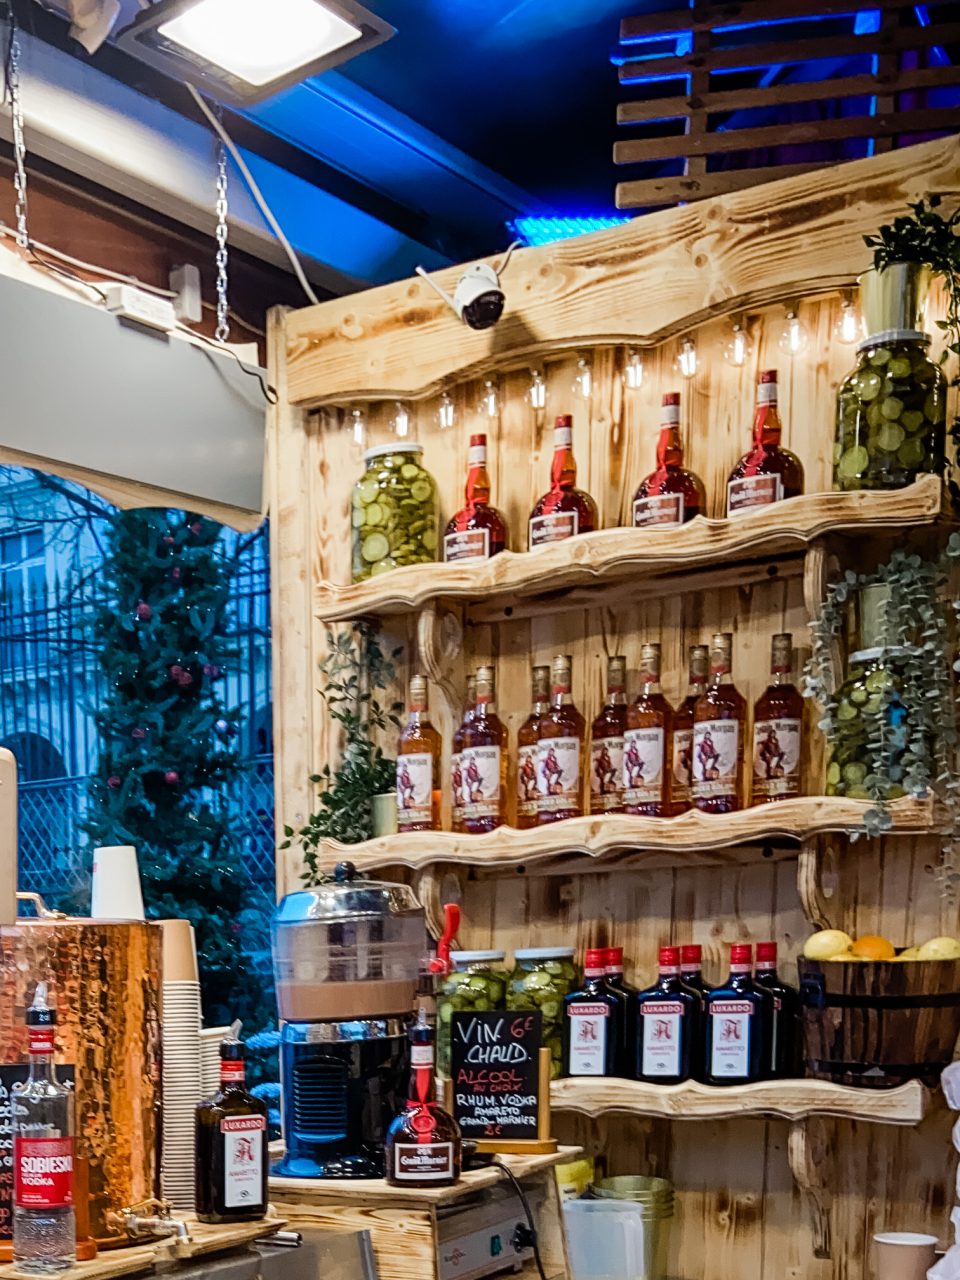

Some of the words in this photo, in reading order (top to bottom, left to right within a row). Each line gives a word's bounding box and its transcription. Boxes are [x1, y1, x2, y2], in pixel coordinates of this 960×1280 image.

[570, 1006, 607, 1015] LUXARDO
[643, 1005, 681, 1014] LUXARDO
[712, 1004, 750, 1013] LUXARDO
[467, 1042, 527, 1063] CHAUD
[457, 1068, 524, 1084] ALCOOL
[500, 1094, 537, 1107] VODKA
[224, 1119, 263, 1131] LUXARDO
[21, 1177, 55, 1186] VODKA
